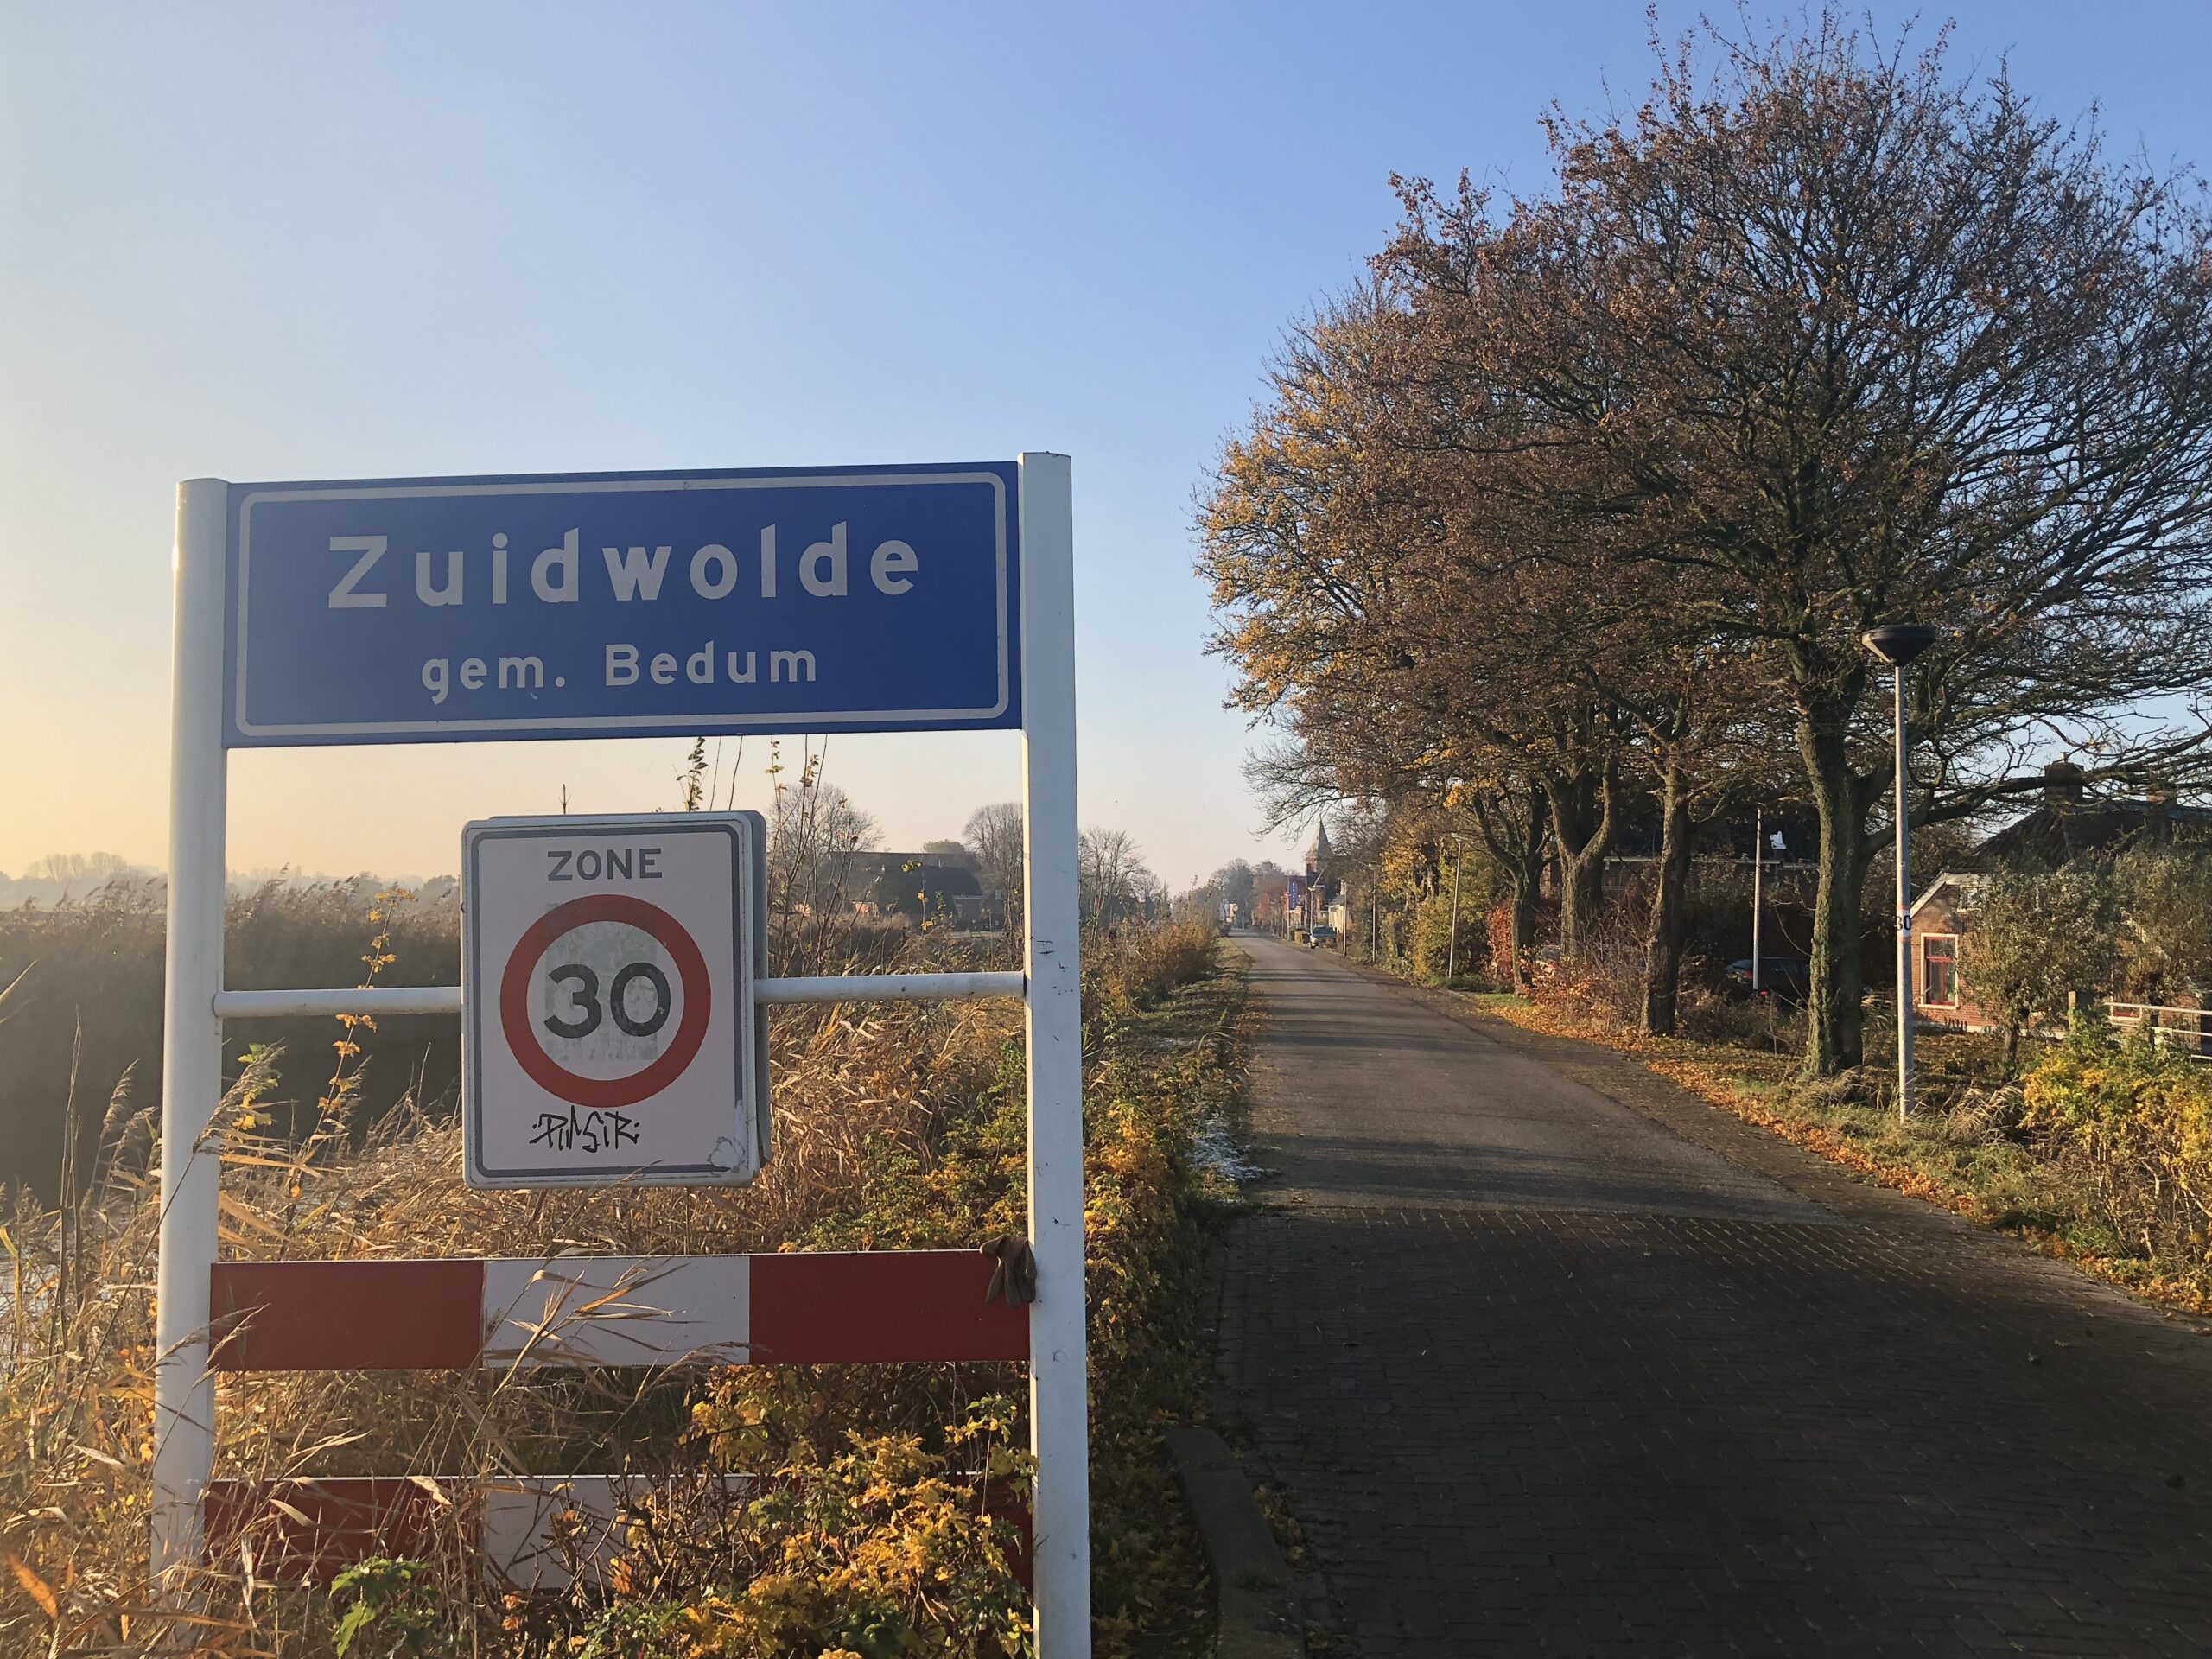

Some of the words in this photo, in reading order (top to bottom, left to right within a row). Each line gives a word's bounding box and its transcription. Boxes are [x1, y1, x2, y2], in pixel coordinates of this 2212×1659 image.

[327, 520, 918, 609] Zuidwolde
[421, 656, 566, 705] gem.
[605, 640, 817, 686] Bedum
[547, 848, 663, 882] ZONE
[543, 962, 671, 1039] 30
